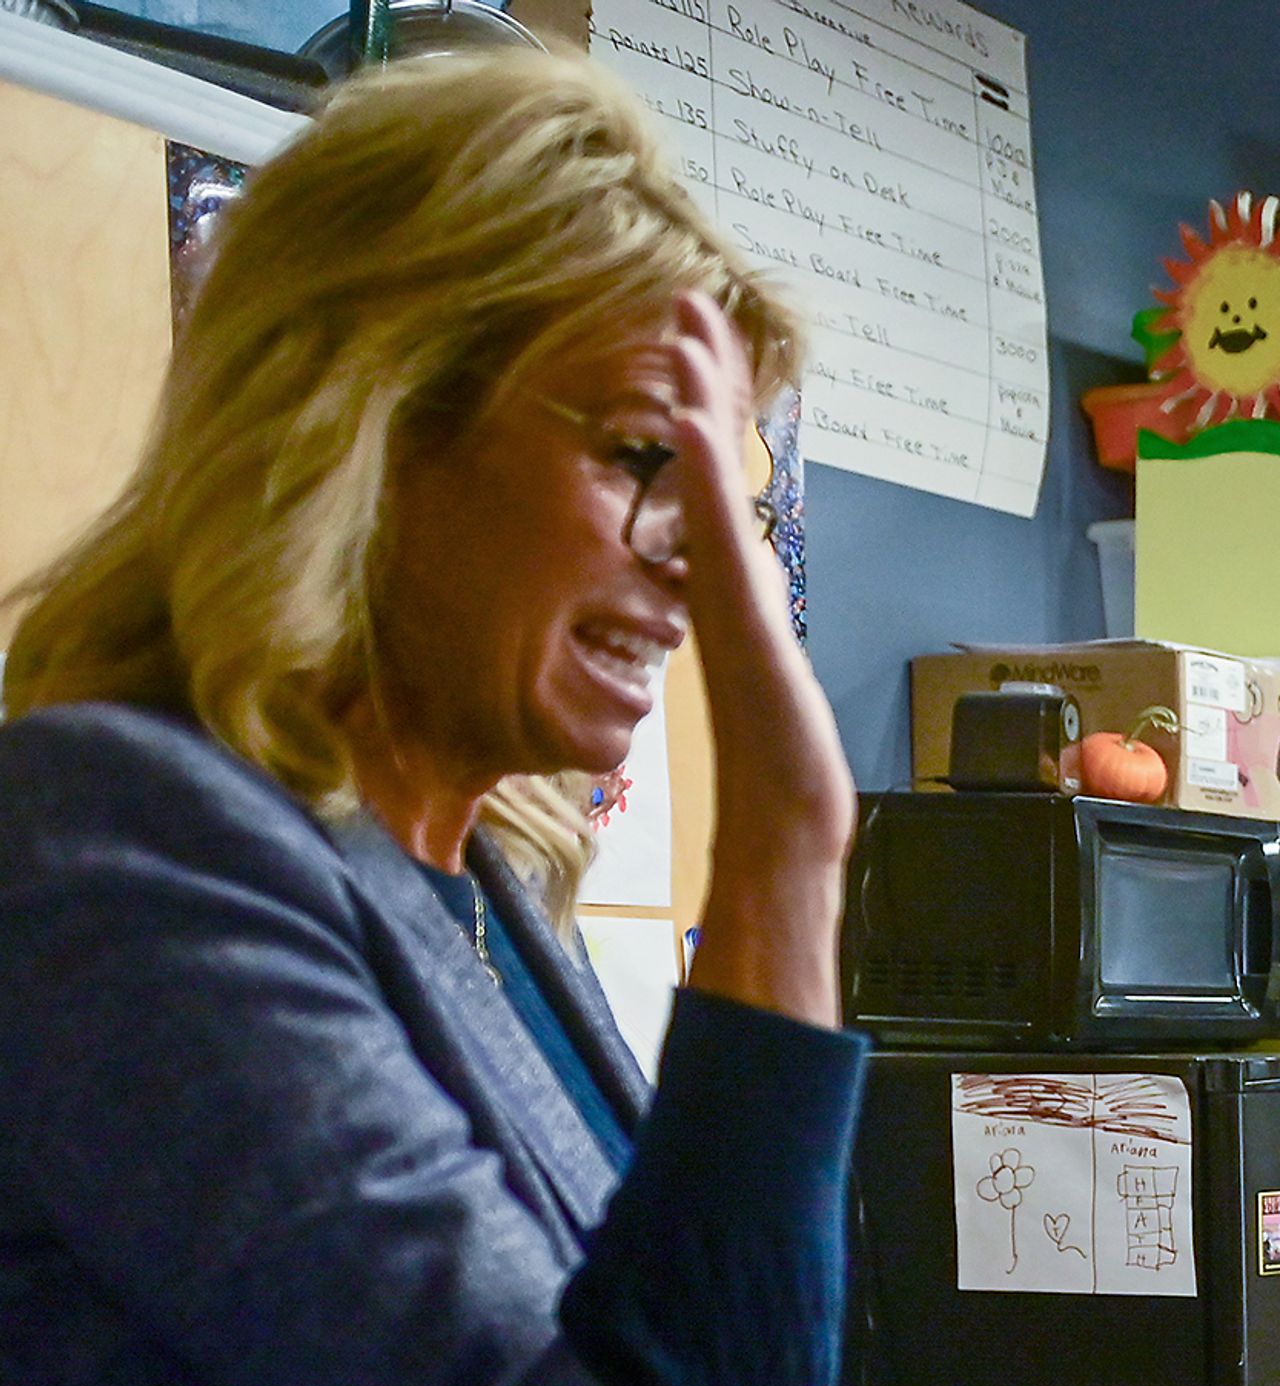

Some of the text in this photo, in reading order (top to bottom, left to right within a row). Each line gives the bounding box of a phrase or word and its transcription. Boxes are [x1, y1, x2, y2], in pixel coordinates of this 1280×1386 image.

[727, 4, 774, 55] Role
[784, 27, 835, 96] Play
[852, 59, 908, 112] Free
[911, 90, 970, 140] Time
[676, 98, 708, 130] 135
[829, 165, 856, 189] on
[863, 171, 912, 210] Desk
[730, 165, 777, 208] Role
[782, 188, 825, 237] Play
[838, 213, 886, 248] Free
[876, 277, 918, 307] Free
[922, 291, 969, 324] Time
[995, 335, 1038, 364] 3000
[850, 368, 901, 400] Free
[903, 384, 950, 416] Time
[1011, 660, 1101, 684] MindWare
[1110, 1138, 1158, 1159] Ariana
